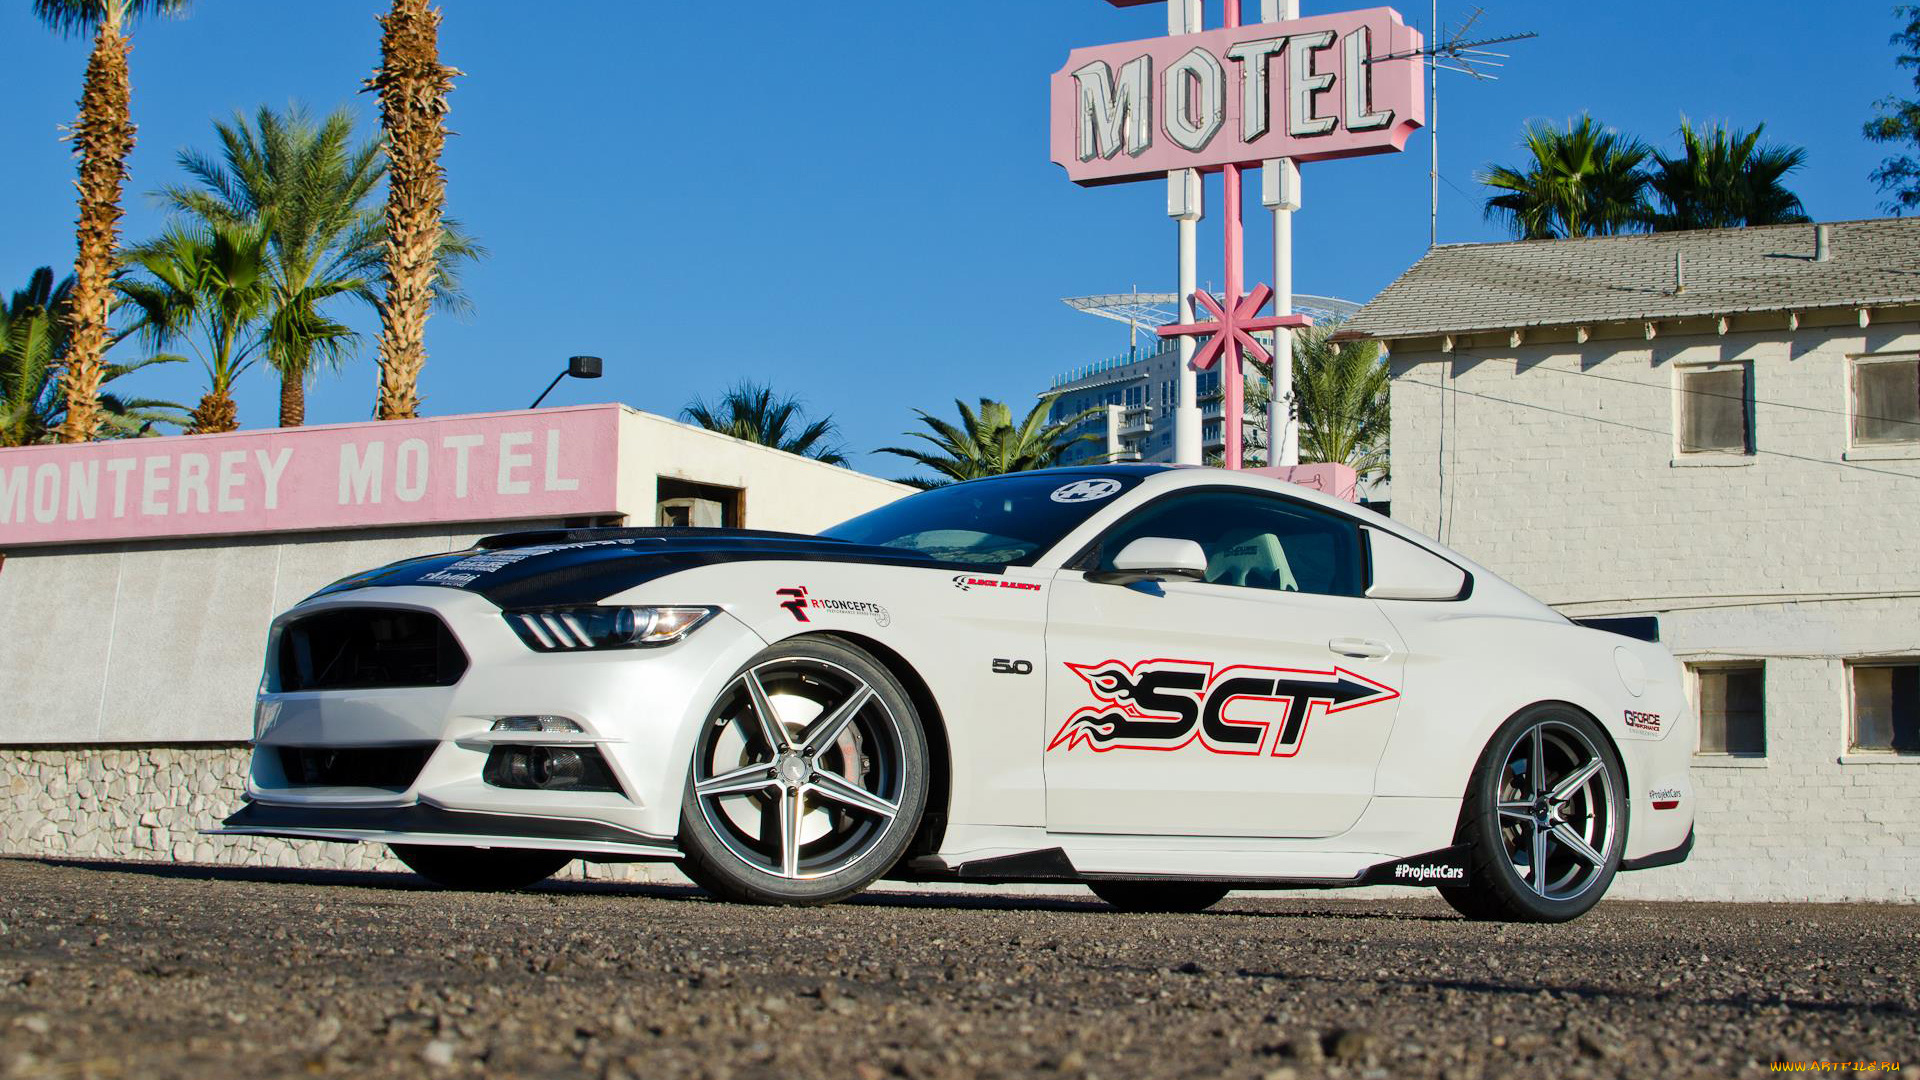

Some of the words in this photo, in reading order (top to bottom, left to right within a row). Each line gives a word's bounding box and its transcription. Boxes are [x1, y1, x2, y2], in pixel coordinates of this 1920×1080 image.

[1072, 26, 1396, 163] MOTEL
[0, 447, 294, 525] MONTEREY
[338, 428, 580, 507] MOTEL
[1070, 668, 1385, 746] SCT
[1395, 863, 1464, 881] #ProjektCars
